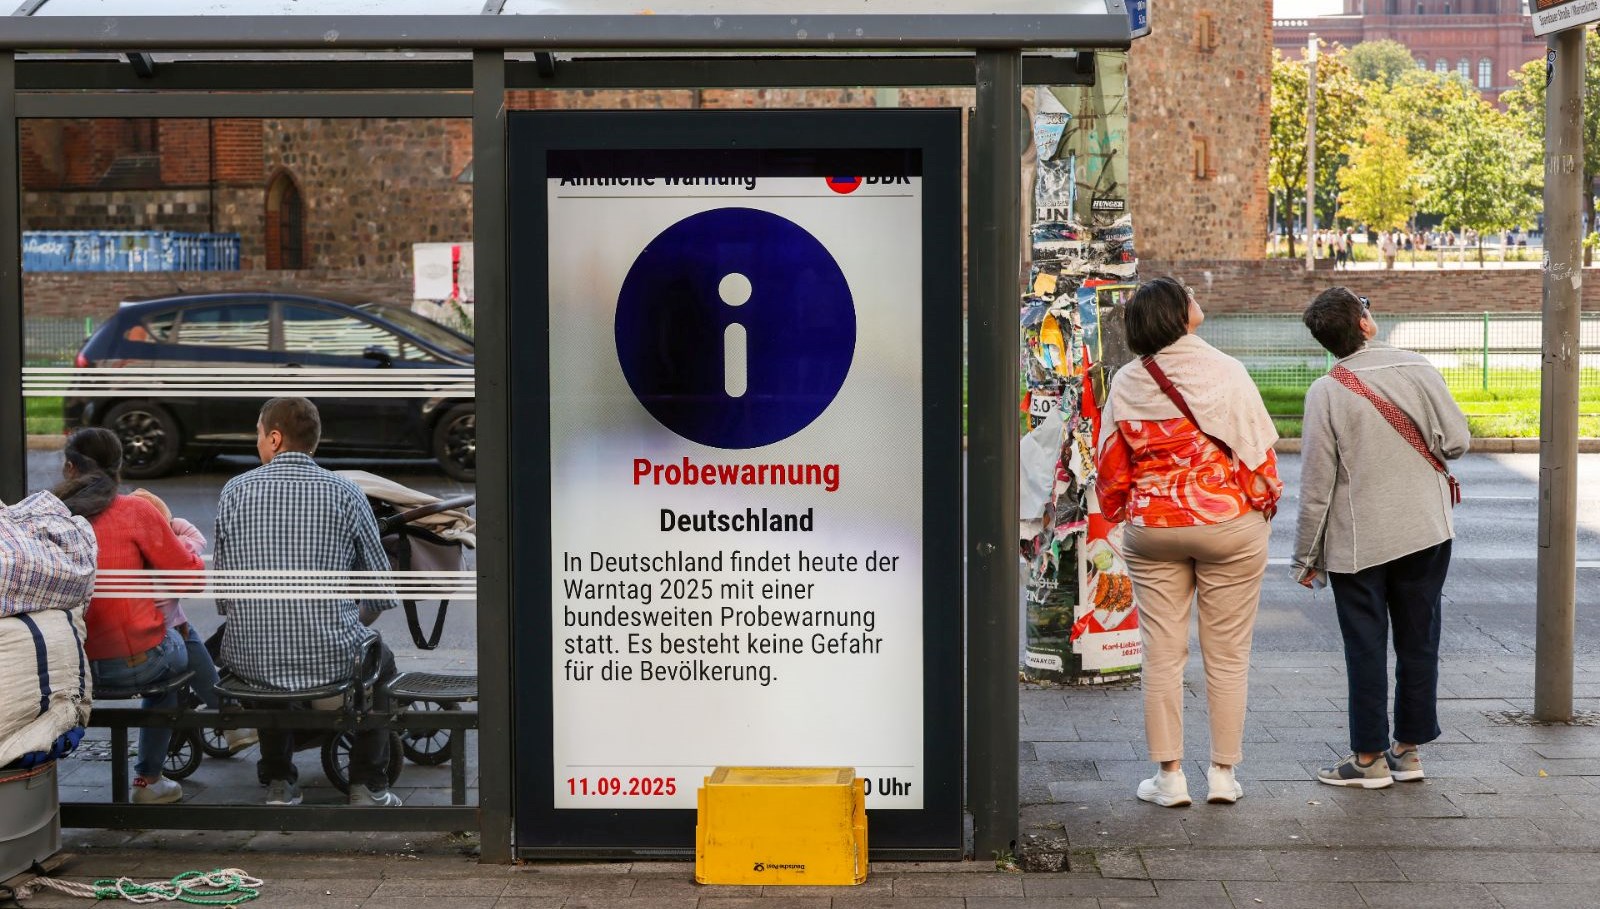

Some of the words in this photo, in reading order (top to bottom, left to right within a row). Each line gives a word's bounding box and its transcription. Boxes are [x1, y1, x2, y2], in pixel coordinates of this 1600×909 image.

[633, 457, 840, 492] Probewarnung
[660, 508, 814, 532] Deutschland
[564, 551, 582, 572] In
[590, 551, 723, 572] Deutschland
[730, 551, 791, 572] findet
[799, 551, 858, 572] heute
[865, 551, 899, 572] der
[564, 579, 652, 605] Warntag
[660, 579, 713, 600] 2025
[721, 579, 754, 600] mit
[761, 579, 815, 600] einer
[564, 605, 713, 627] bundesweiten
[721, 605, 875, 632] Probewarnung
[564, 634, 619, 654] statt.
[628, 633, 653, 654] Es
[660, 633, 740, 654] besteht
[748, 633, 804, 654] keine
[812, 633, 883, 654] Gefahr
[564, 660, 594, 681] für
[601, 660, 633, 681] die
[640, 660, 777, 687] Bevölkerung.
[567, 777, 677, 796] 11.09.2025
[878, 777, 912, 796] Uhr
